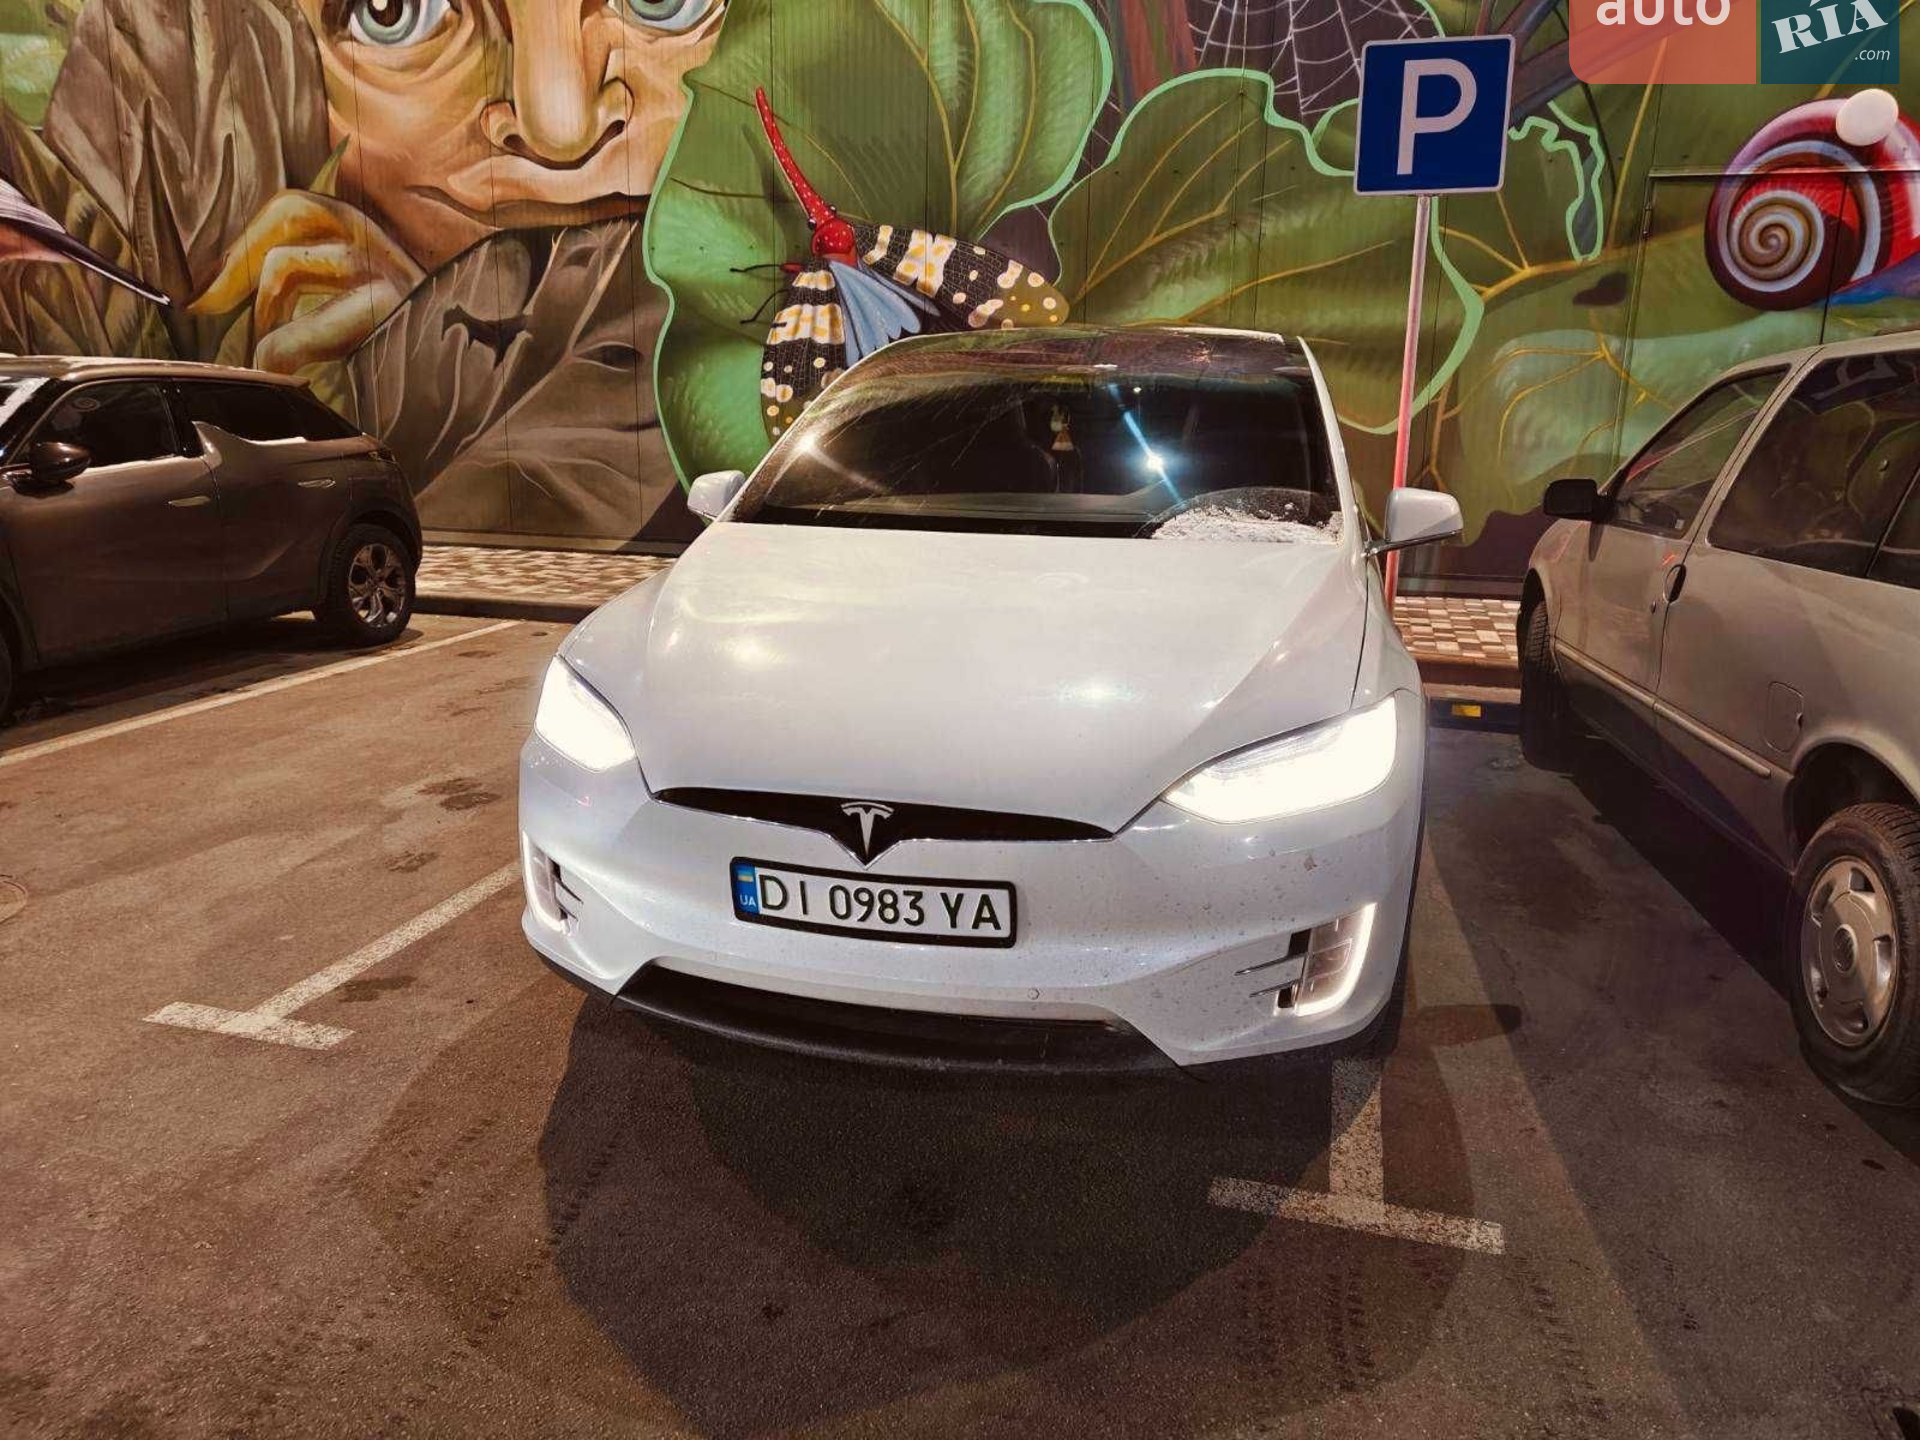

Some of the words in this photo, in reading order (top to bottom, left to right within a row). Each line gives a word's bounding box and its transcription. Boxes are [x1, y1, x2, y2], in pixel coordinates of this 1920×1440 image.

[1397, 57, 1477, 175] P
[739, 894, 757, 908] UA
[758, 874, 808, 915] DI
[828, 884, 925, 926] 0983
[940, 892, 1002, 930] YA
